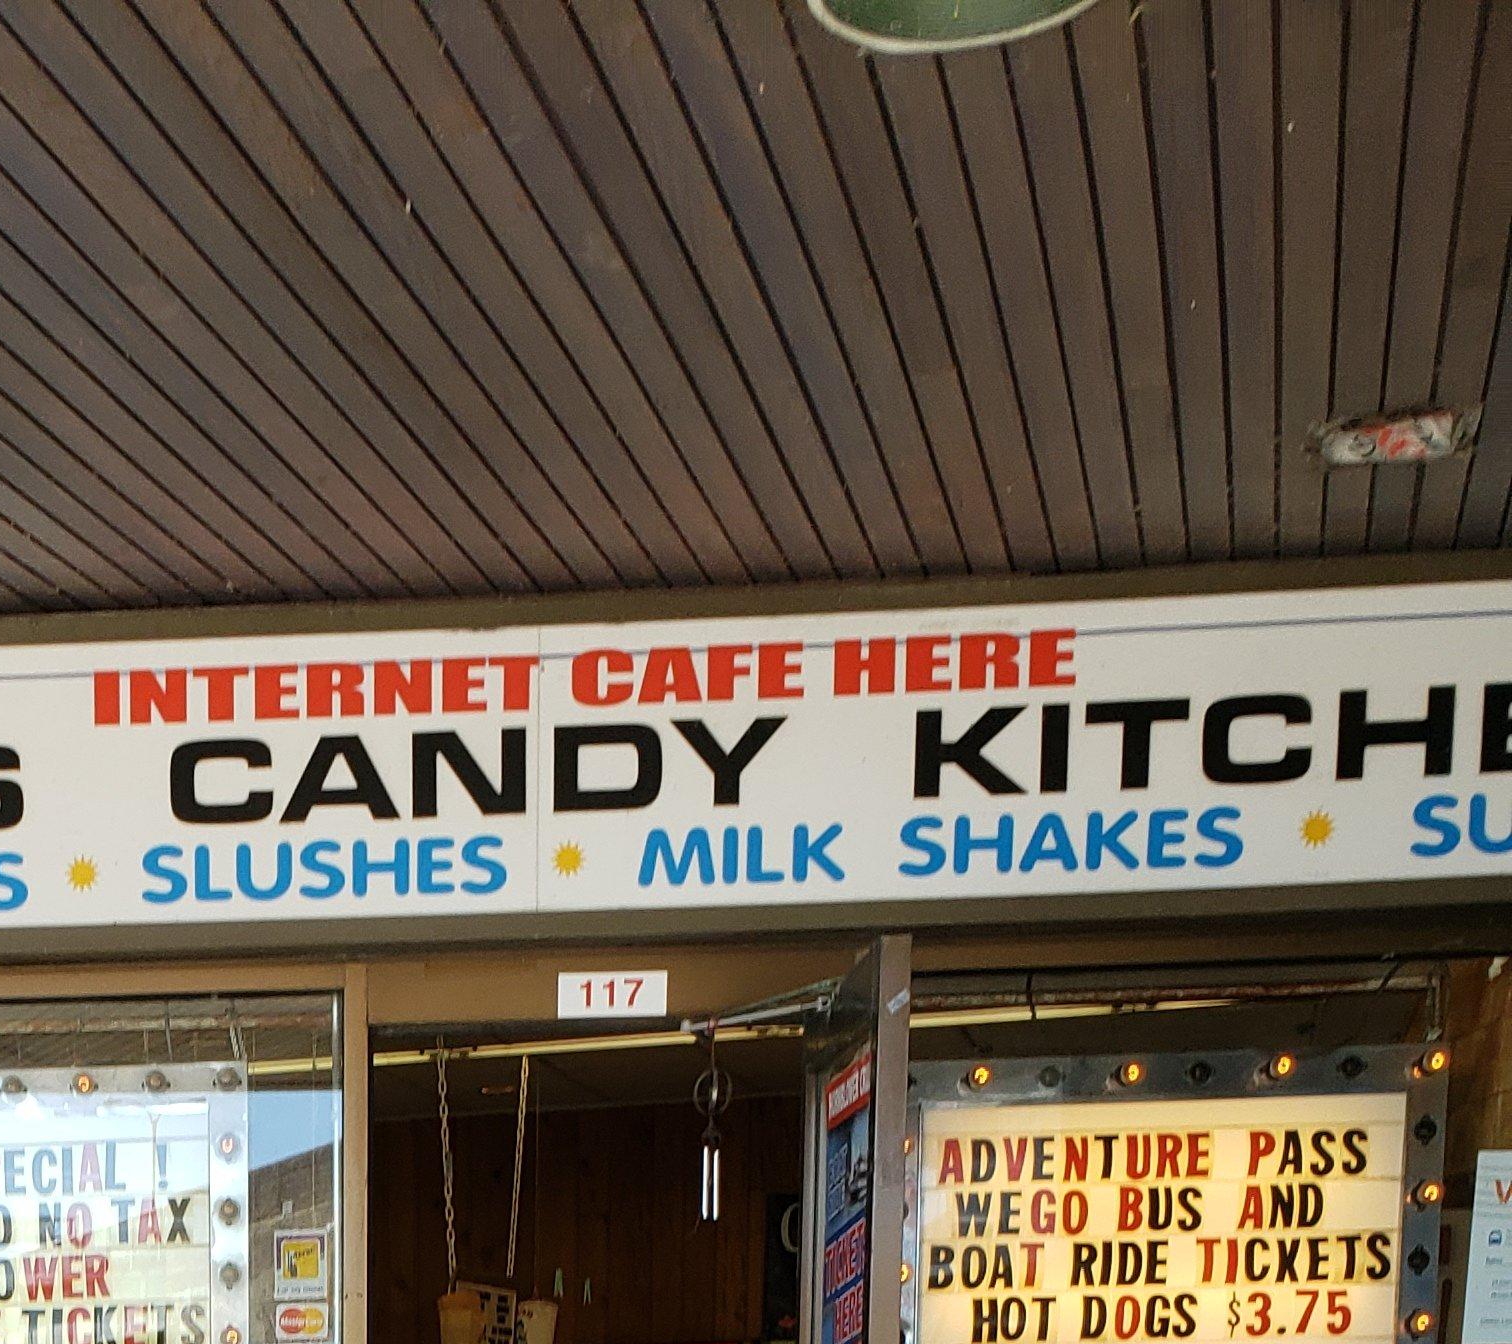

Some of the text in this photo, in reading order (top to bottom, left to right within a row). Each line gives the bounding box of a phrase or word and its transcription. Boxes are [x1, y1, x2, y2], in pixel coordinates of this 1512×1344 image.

[93, 627, 1077, 727] INTERNET CAFE HERE
[169, 714, 788, 825] CANDY
[141, 834, 508, 904] SLUSHES
[638, 806, 1244, 887] MILK SHAKES
[579, 979, 646, 1007] 117
[938, 1129, 1369, 1186] ADVENTURE PASS
[38, 1200, 94, 1250] NO
[117, 1196, 191, 1247] TAX
[954, 1183, 1324, 1239] WEGO BUS AND
[927, 1232, 1392, 1292] BOAT RIDE TICKETS
[971, 1289, 1353, 1344] HOT DOGS $3.75
